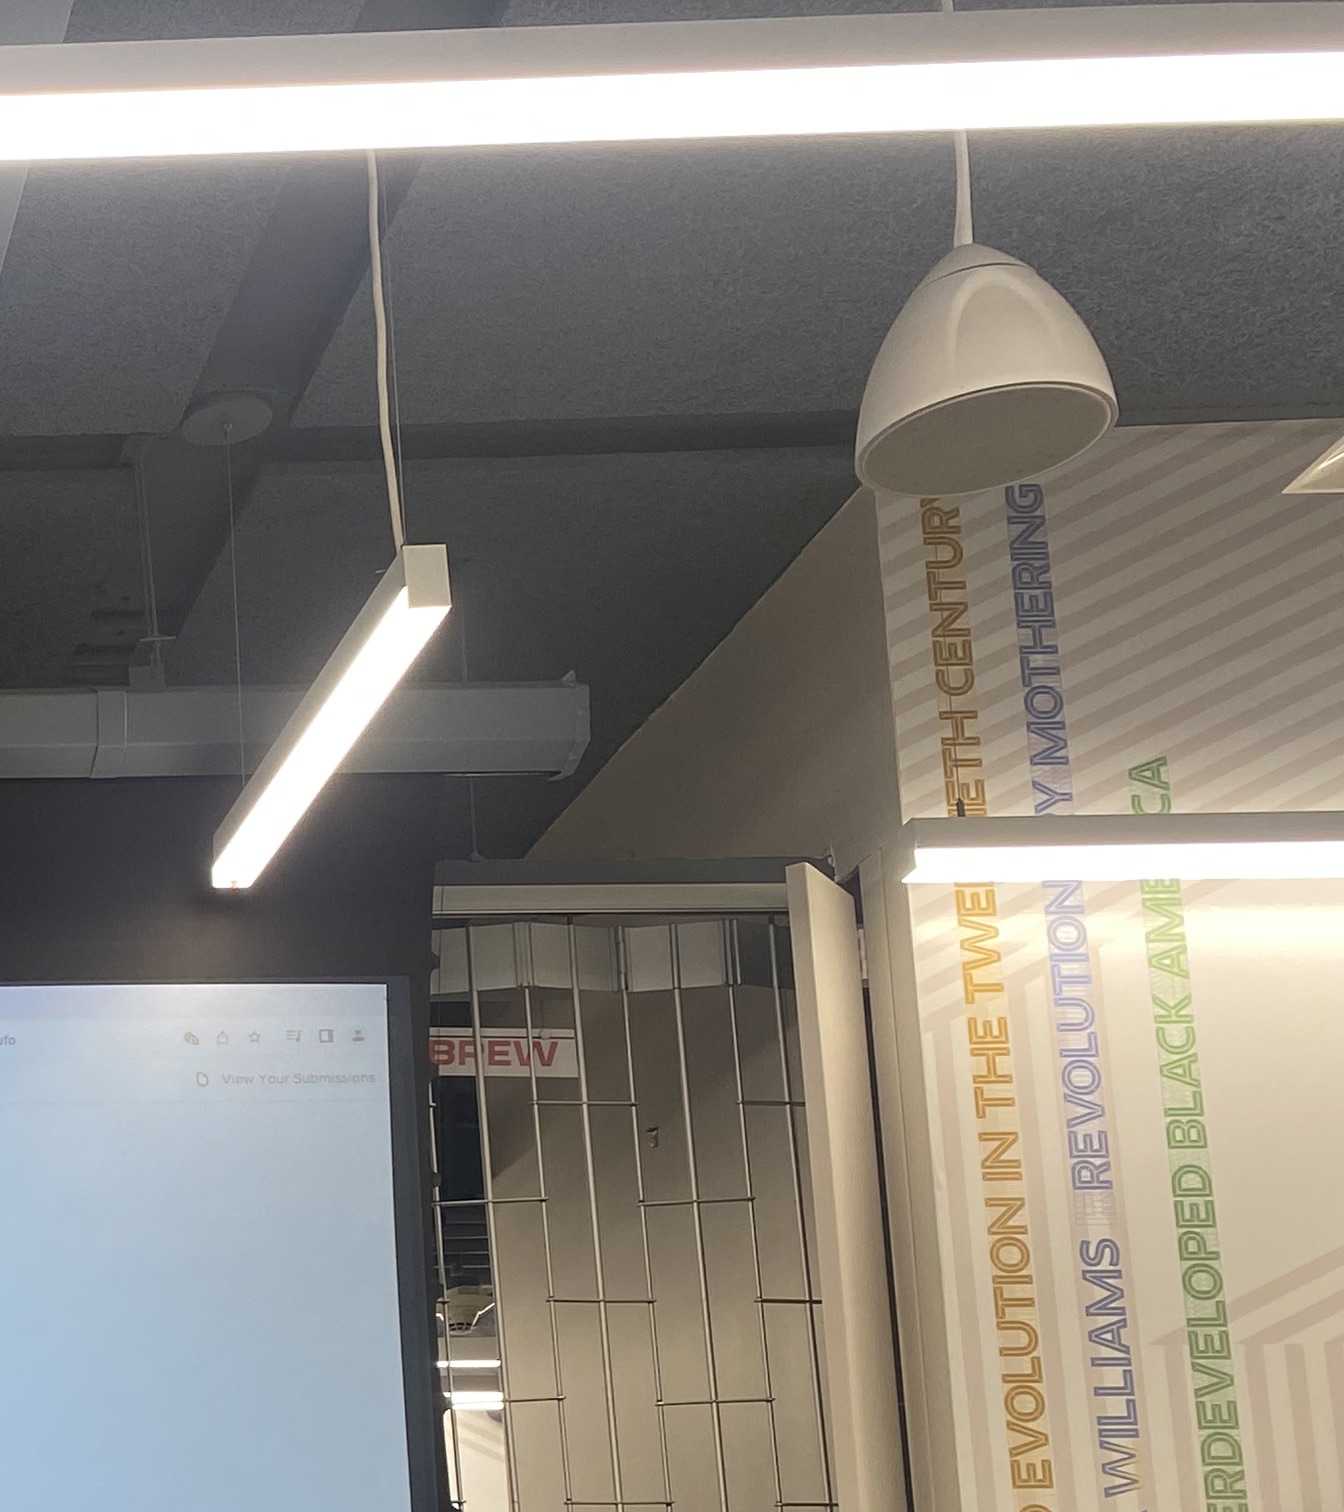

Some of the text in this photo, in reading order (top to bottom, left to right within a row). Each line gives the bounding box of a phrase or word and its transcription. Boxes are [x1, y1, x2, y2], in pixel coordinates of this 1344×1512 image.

[919, 497, 975, 698] CENTUR
[1004, 483, 1070, 767] MOTHERING
[967, 1016, 1015, 1120] THE
[977, 1131, 1023, 1182] IN
[1153, 993, 1208, 1150] BLACK
[984, 1196, 1054, 1489] EVOLUTION
[1079, 1237, 1144, 1498] WILLIAMS
